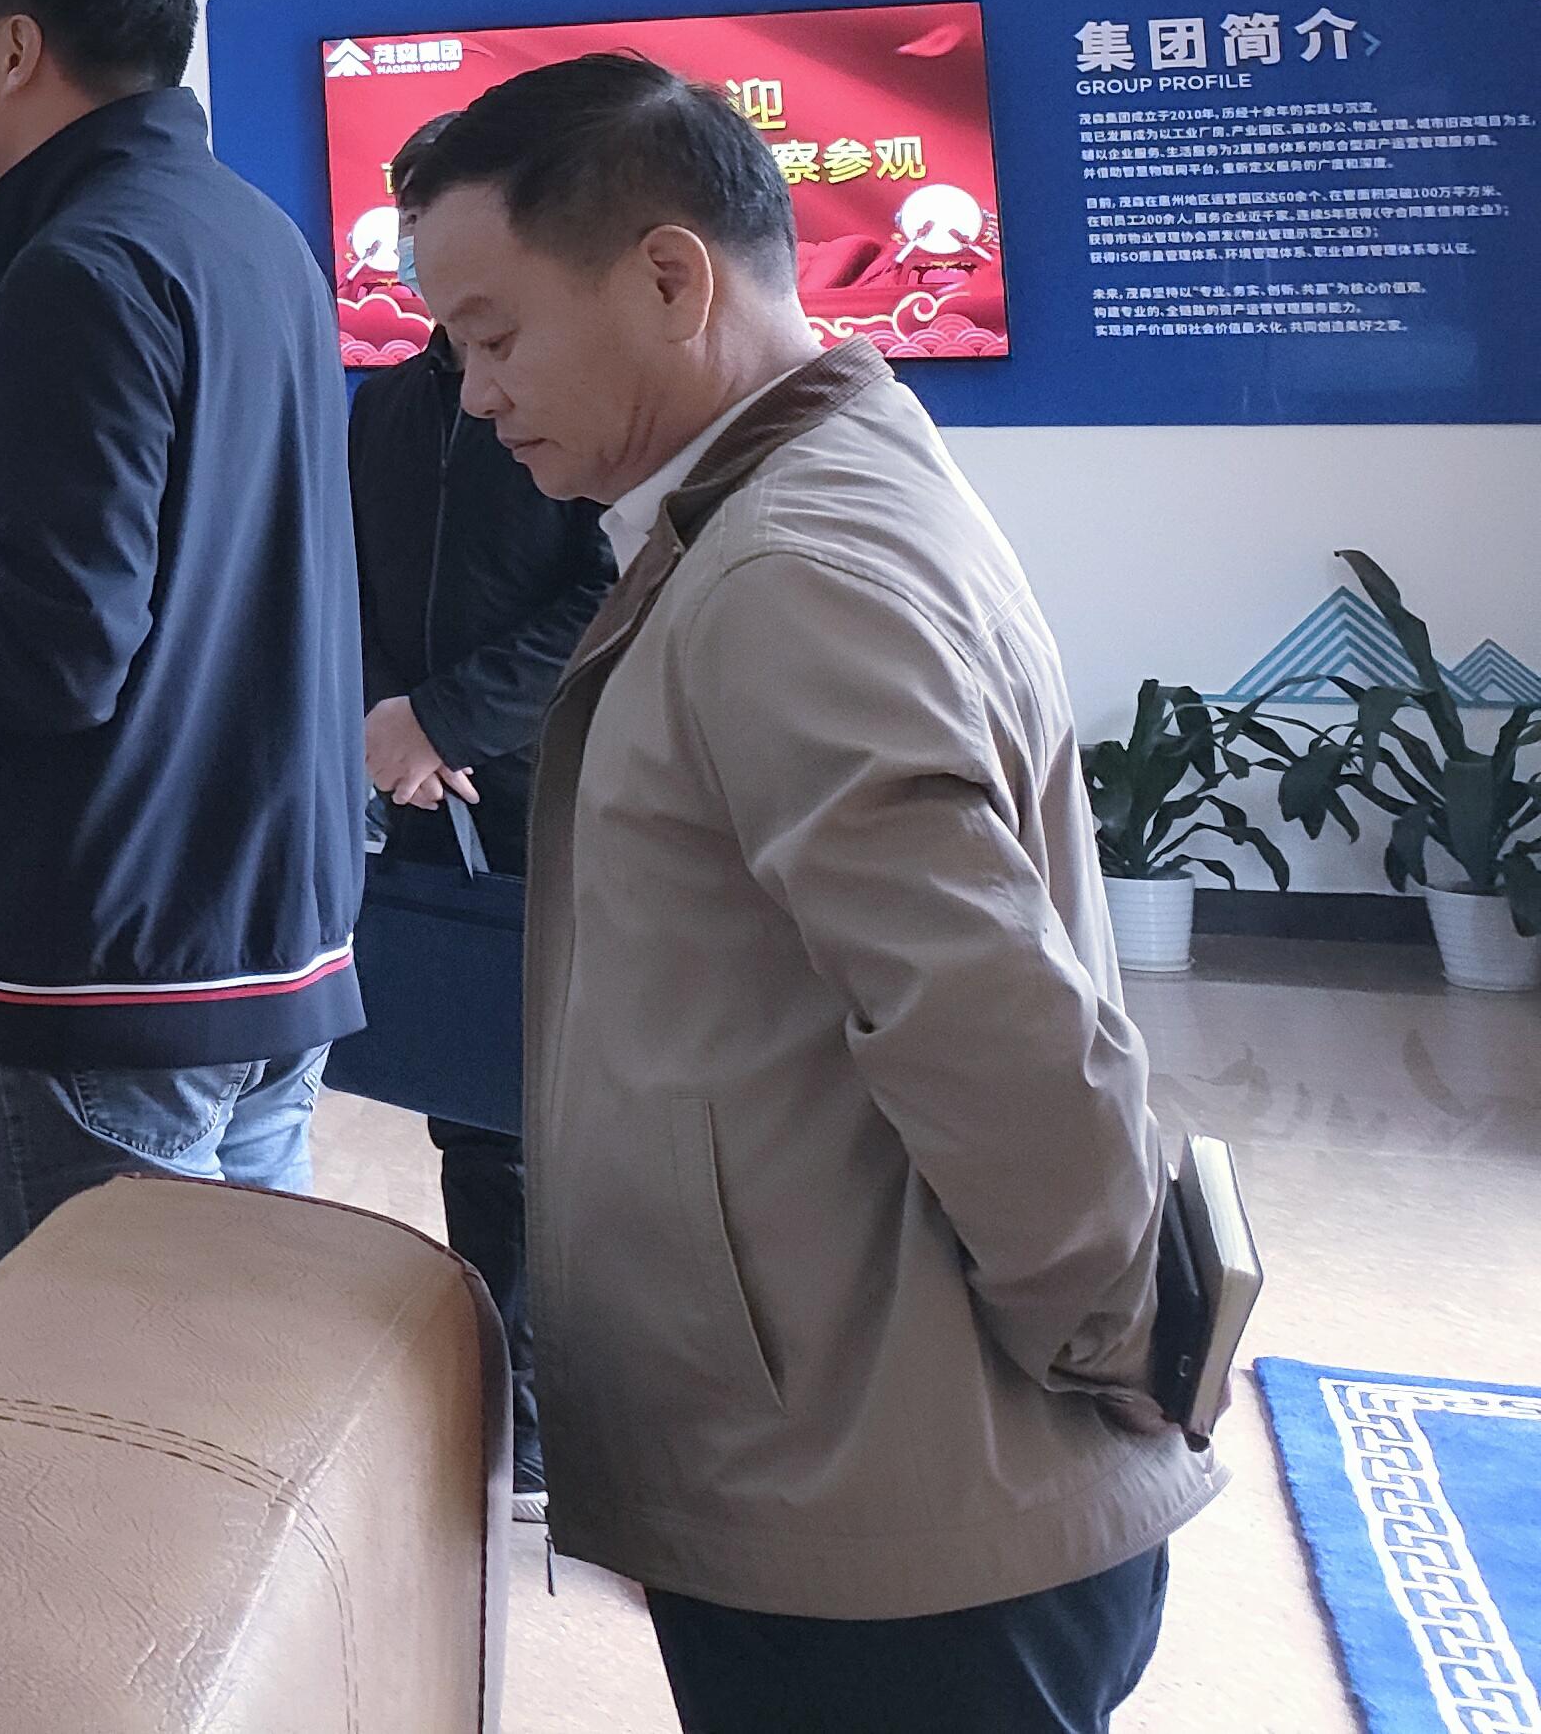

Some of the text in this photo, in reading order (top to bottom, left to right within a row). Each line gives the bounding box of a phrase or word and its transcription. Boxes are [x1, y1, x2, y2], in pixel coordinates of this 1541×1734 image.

[372, 39, 463, 64] 茂森集团
[1073, 7, 1358, 73] 集团简介
[422, 61, 460, 73] GROUP
[1075, 72, 1253, 95] GROUP PROFILE
